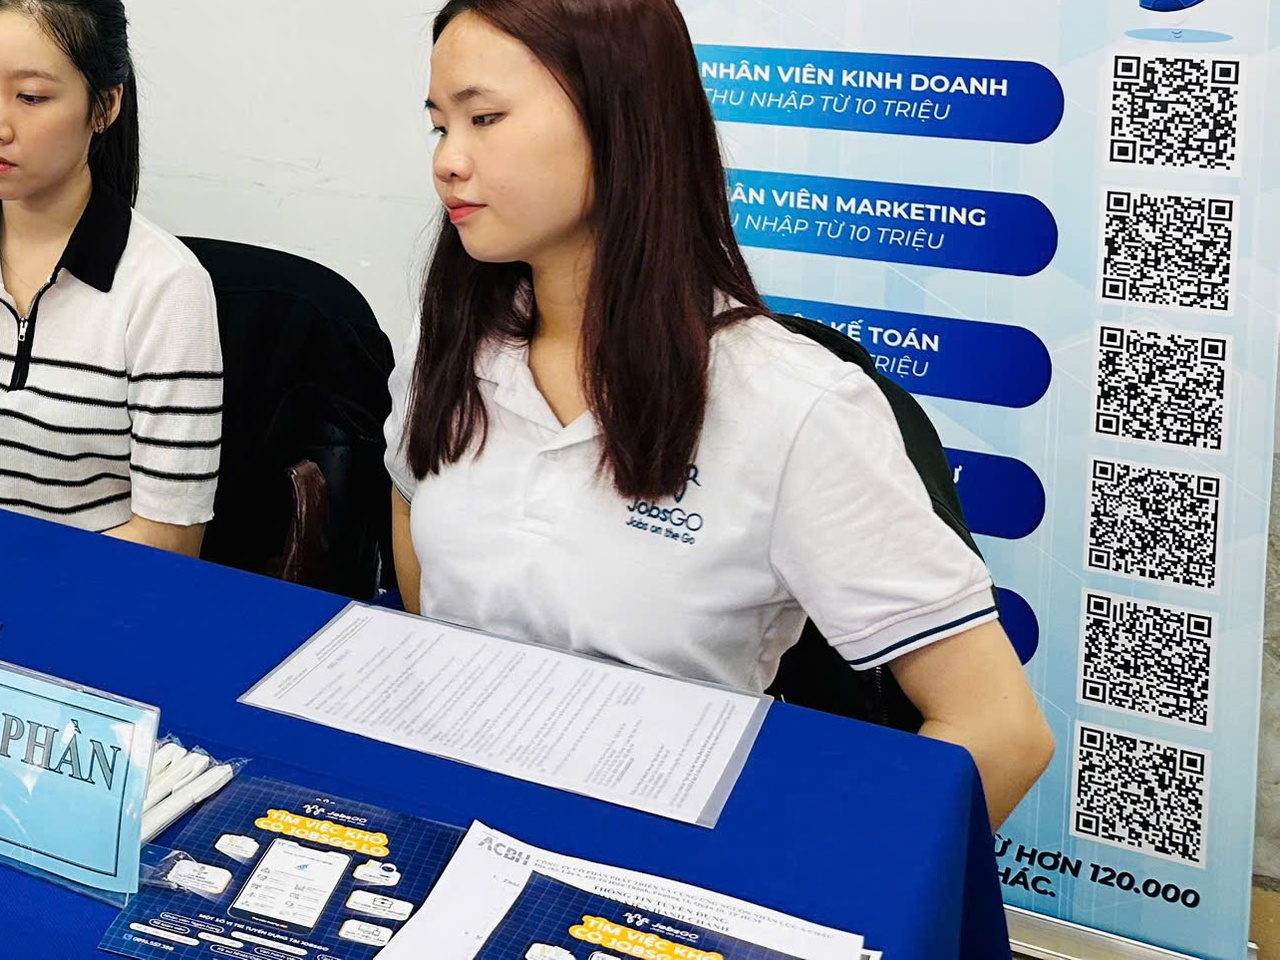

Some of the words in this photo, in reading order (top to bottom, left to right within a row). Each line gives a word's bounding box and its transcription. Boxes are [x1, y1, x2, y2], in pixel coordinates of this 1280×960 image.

[701, 60, 771, 82] NHÂN
[776, 63, 834, 86] VIÊN
[841, 69, 903, 90] KINH
[910, 73, 1008, 97] DOANH
[749, 90, 815, 113] NHẬP
[820, 93, 851, 113] TỪ
[855, 98, 877, 115] 10
[883, 99, 952, 122] TRIỆU
[730, 182, 765, 205] ÂN
[771, 188, 829, 211] VIÊN
[835, 195, 987, 227] MARKETING
[744, 214, 809, 237] NHẬP
[814, 220, 846, 239] TỪ
[849, 224, 871, 242] 10
[876, 227, 945, 251] TRIỆU
[868, 327, 940, 352] TOÁN
[288, 826, 358, 849] JOBSGO
[996, 866, 1057, 898] HÁC.
[1015, 844, 1083, 878] HƠN
[1089, 863, 1201, 909] 120.000
